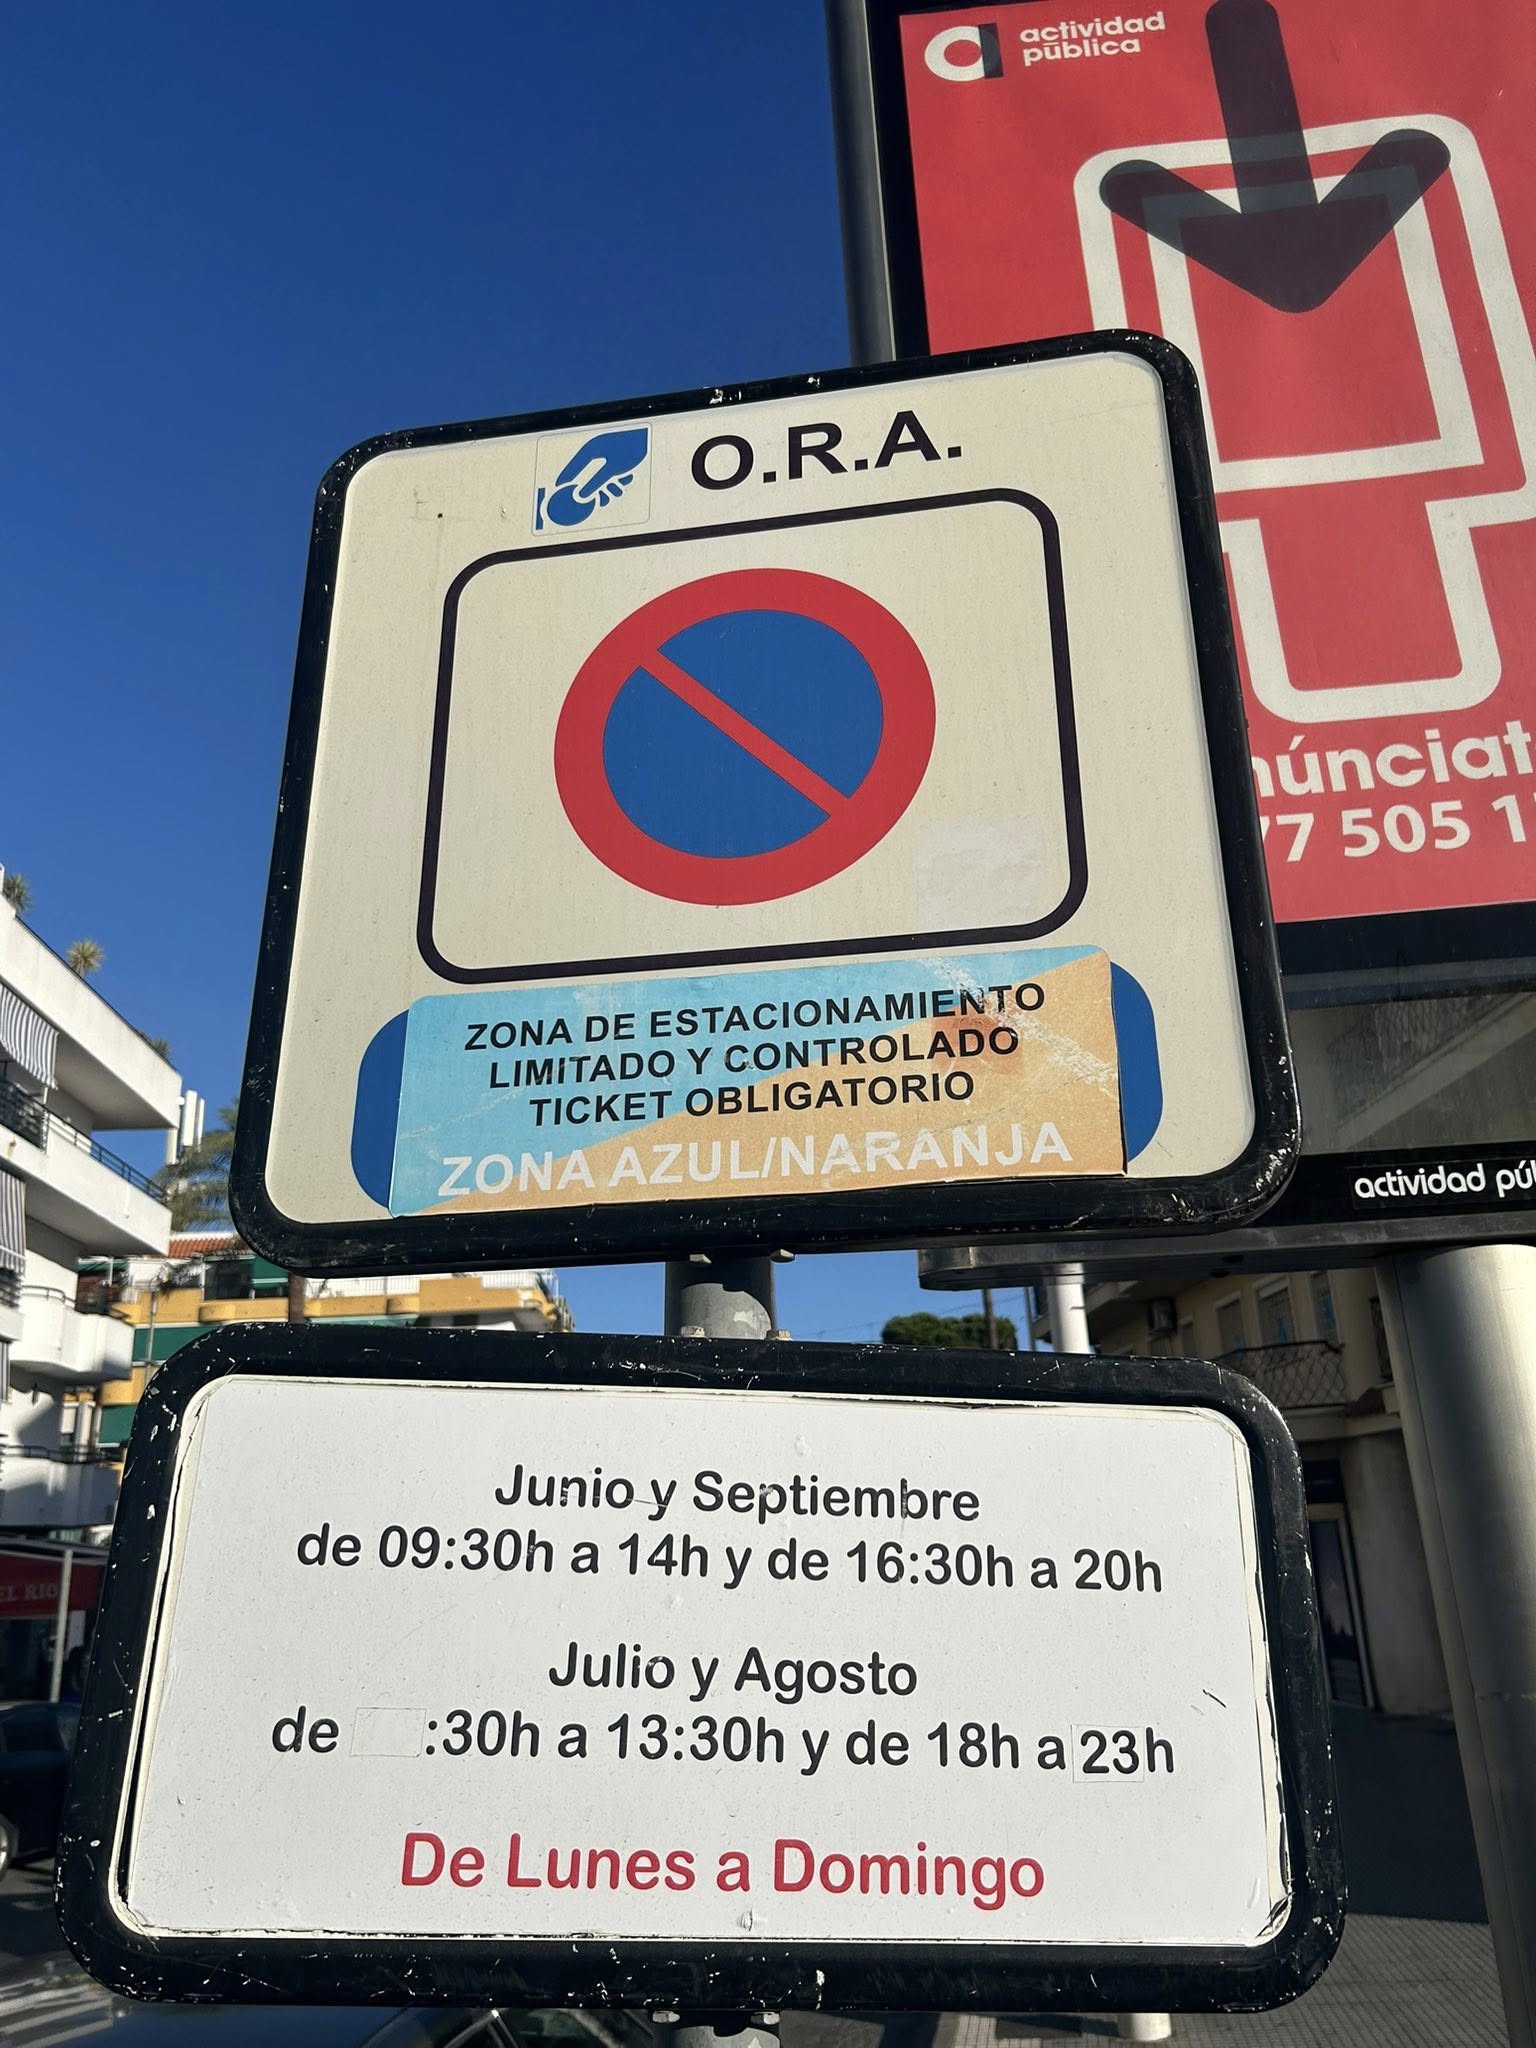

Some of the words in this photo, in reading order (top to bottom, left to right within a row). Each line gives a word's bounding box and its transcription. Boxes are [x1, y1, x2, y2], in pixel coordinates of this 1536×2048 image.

[1019, 11, 1166, 43] actividad
[1023, 36, 1141, 67] pública
[691, 410, 962, 491] O.R.A.
[1251, 720, 1536, 798] núnciat
[1341, 800, 1471, 858] 505
[1491, 792, 1536, 843] 1
[464, 1017, 573, 1051] ZONA
[585, 1013, 636, 1042] DE
[650, 982, 1046, 1038] ESTACIONAMIENTO
[489, 1048, 676, 1090] LIMITADO
[687, 1047, 713, 1075] Y
[724, 1026, 1019, 1073] CONTROLADO
[529, 1090, 673, 1127] TICKET
[685, 1071, 975, 1117] OBLIGATORIO
[438, 1152, 596, 1198] ZONA
[608, 1122, 1073, 1185] AZUL/NARANJA
[1354, 1163, 1486, 1199] actividad
[495, 1464, 635, 1509] Junio
[648, 1479, 677, 1522] y
[693, 1470, 980, 1525] Septiembre
[297, 1522, 362, 1567] de
[379, 1525, 554, 1573] 09:30h
[570, 1540, 600, 1574] a
[619, 1533, 709, 1578] 14h
[724, 1546, 752, 1590] y
[767, 1537, 830, 1582] de
[846, 1540, 1014, 1588] 16:30h
[1030, 1557, 1059, 1589] a
[1073, 1549, 1162, 1593] 20h
[549, 1642, 676, 1689] Julio
[689, 1657, 720, 1702] y
[734, 1647, 918, 1704] Agosto
[271, 1706, 340, 1754] de
[557, 1724, 588, 1759] a
[607, 1713, 785, 1763] 13:30h
[800, 1730, 830, 1776] y
[845, 1719, 909, 1766] de
[927, 1721, 1020, 1769] 18h
[1037, 1736, 1067, 1771] a
[1080, 1727, 1175, 1775] 23h
[401, 1833, 485, 1888] De
[507, 1833, 696, 1890] Lunes
[716, 1849, 751, 1893] a
[773, 1839, 1045, 1912] Domingo
